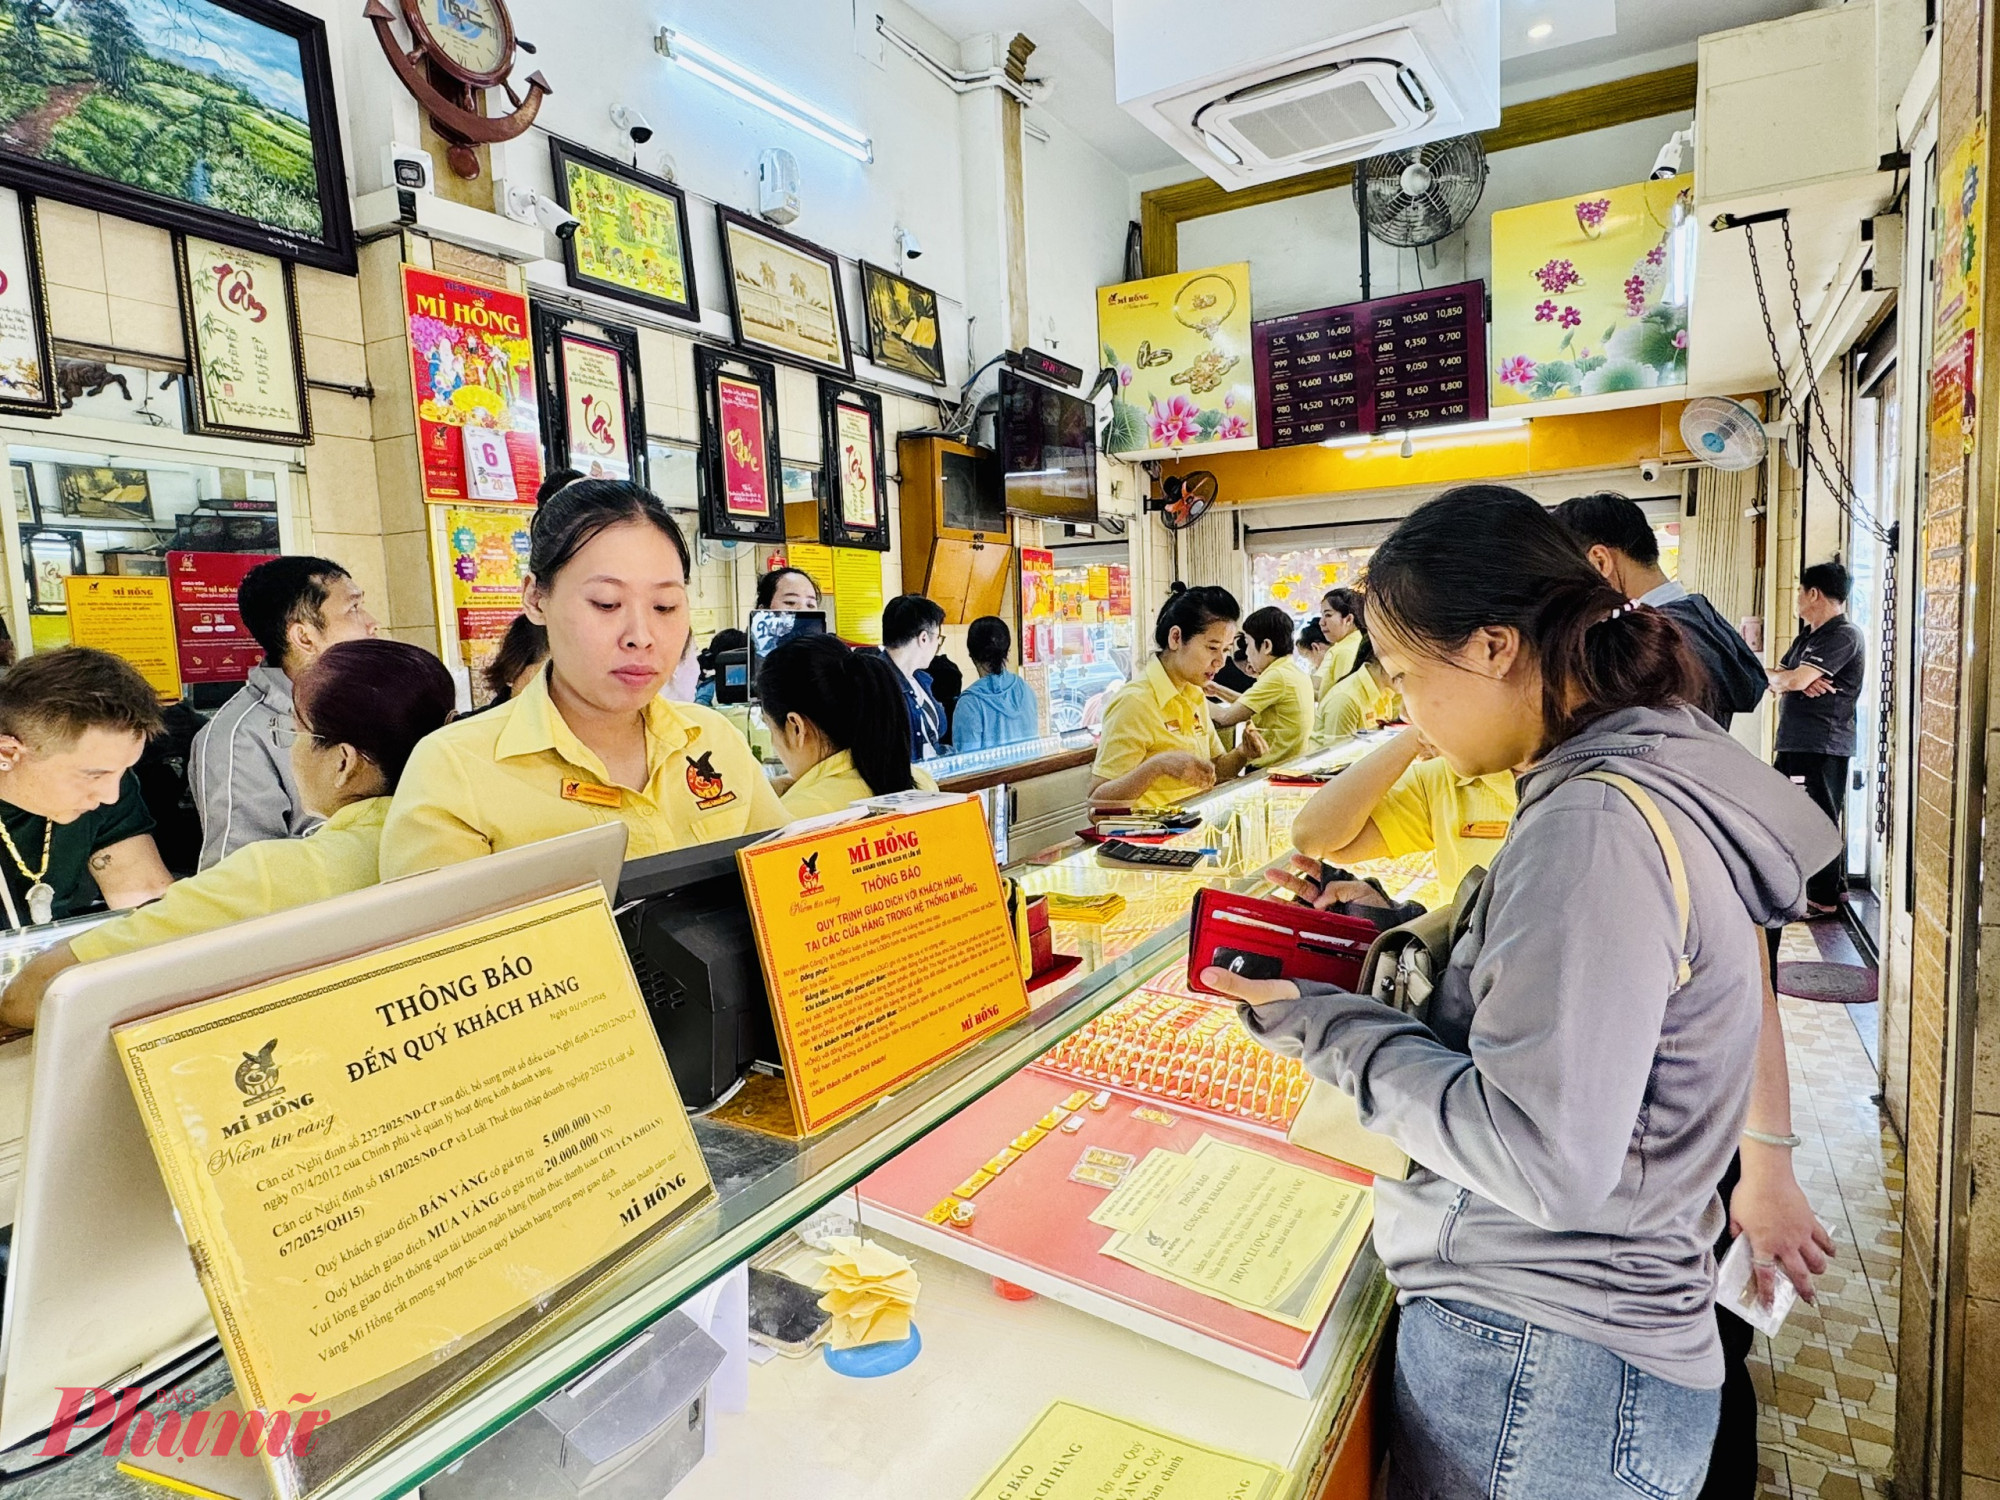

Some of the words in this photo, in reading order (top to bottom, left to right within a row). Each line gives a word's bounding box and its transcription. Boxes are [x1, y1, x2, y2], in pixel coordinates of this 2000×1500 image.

[453, 297, 520, 335] HỒNG
[1376, 317, 1392, 328] 750
[1402, 311, 1428, 325] 10,500
[1435, 305, 1463, 319] 10,850
[1272, 335, 1286, 346] SJC
[1295, 329, 1319, 343] 16,300
[1325, 324, 1351, 338] 16,450
[1377, 341, 1393, 353] 680
[1404, 336, 1427, 349] 9,350
[1438, 330, 1461, 344] 9,700
[1273, 358, 1288, 369] 999
[1296, 353, 1321, 366] 16,300
[1327, 348, 1352, 361] 16,450
[1378, 365, 1394, 376] 610
[1405, 360, 1428, 373] 9,050
[1439, 355, 1462, 368] 9,400
[1274, 381, 1289, 392] 985
[1297, 376, 1322, 389] 14,600
[1328, 371, 1353, 384] 14,850
[1379, 389, 1395, 400] 580
[1406, 384, 1429, 397] 8,450
[1439, 379, 1463, 392] 8,800
[1276, 404, 1290, 414] 980
[1298, 399, 1323, 412] 14,520
[1329, 395, 1354, 408] 14,770
[1380, 412, 1396, 423] 410
[1407, 408, 1429, 420] 5,750
[1440, 403, 1463, 416] 6,100
[1277, 426, 1292, 437] 950
[1300, 422, 1324, 434] 14,080
[1339, 419, 1345, 429] 0
[482, 443, 498, 467] 6
[873, 825, 918, 857] HỒNG
[860, 871, 899, 894] THÔNG
[899, 864, 921, 882] BÁO
[815, 916, 835, 932] QUY
[836, 907, 863, 925] TRÌNH
[863, 899, 884, 916] GIAO
[883, 893, 904, 909] DỊCH
[917, 880, 943, 897] KHÁCH
[803, 938, 821, 953] TẠI
[820, 931, 841, 947] CÁC
[860, 915, 885, 933] HÀNG
[884, 905, 913, 923] TRONG
[375, 974, 477, 1026] THÔNG
[481, 955, 532, 989] BÁO
[973, 1003, 999, 1025] HỒNG
[346, 1046, 397, 1082] ĐẾN
[402, 1022, 447, 1060] QUÝ
[453, 997, 524, 1038] KHÁCH
[526, 975, 579, 1008] HÀNG
[255, 1092, 314, 1125] HỒNG
[296, 1113, 334, 1138] vàng
[314, 1255, 337, 1277] Quý
[338, 1238, 373, 1263] khách
[373, 1226, 396, 1247] giao
[396, 1211, 419, 1231] dịch
[418, 1192, 448, 1218] BÁN
[448, 1170, 488, 1198] VÀNG
[488, 1164, 500, 1179] có
[500, 1157, 515, 1175] giá
[542, 1113, 591, 1148] 5.000.000
[642, 1173, 686, 1210] HỒNG
[324, 1281, 348, 1303] Quý
[348, 1263, 381, 1289] khách
[381, 1251, 404, 1273] giao
[404, 1236, 427, 1256] dịch
[426, 1215, 460, 1242] MUA
[460, 1191, 499, 1219] VÀNG
[499, 1185, 511, 1199] có
[511, 1179, 525, 1195] giá
[543, 1132, 598, 1172] 20.000.000
[278, 1205, 365, 1257] 67/2025/QH15)
[364, 1310, 394, 1334] Hồng
[407, 1284, 436, 1306] mong
[507, 1219, 533, 1241] khách
[531, 1208, 553, 1225] hàng
[1049, 1442, 1083, 1478] HÀNG
[1123, 1441, 1145, 1460] Quý
[1143, 1448, 1166, 1466] Quý
[1007, 1465, 1034, 1491] BÁO
[1161, 1455, 1184, 1482] chính
